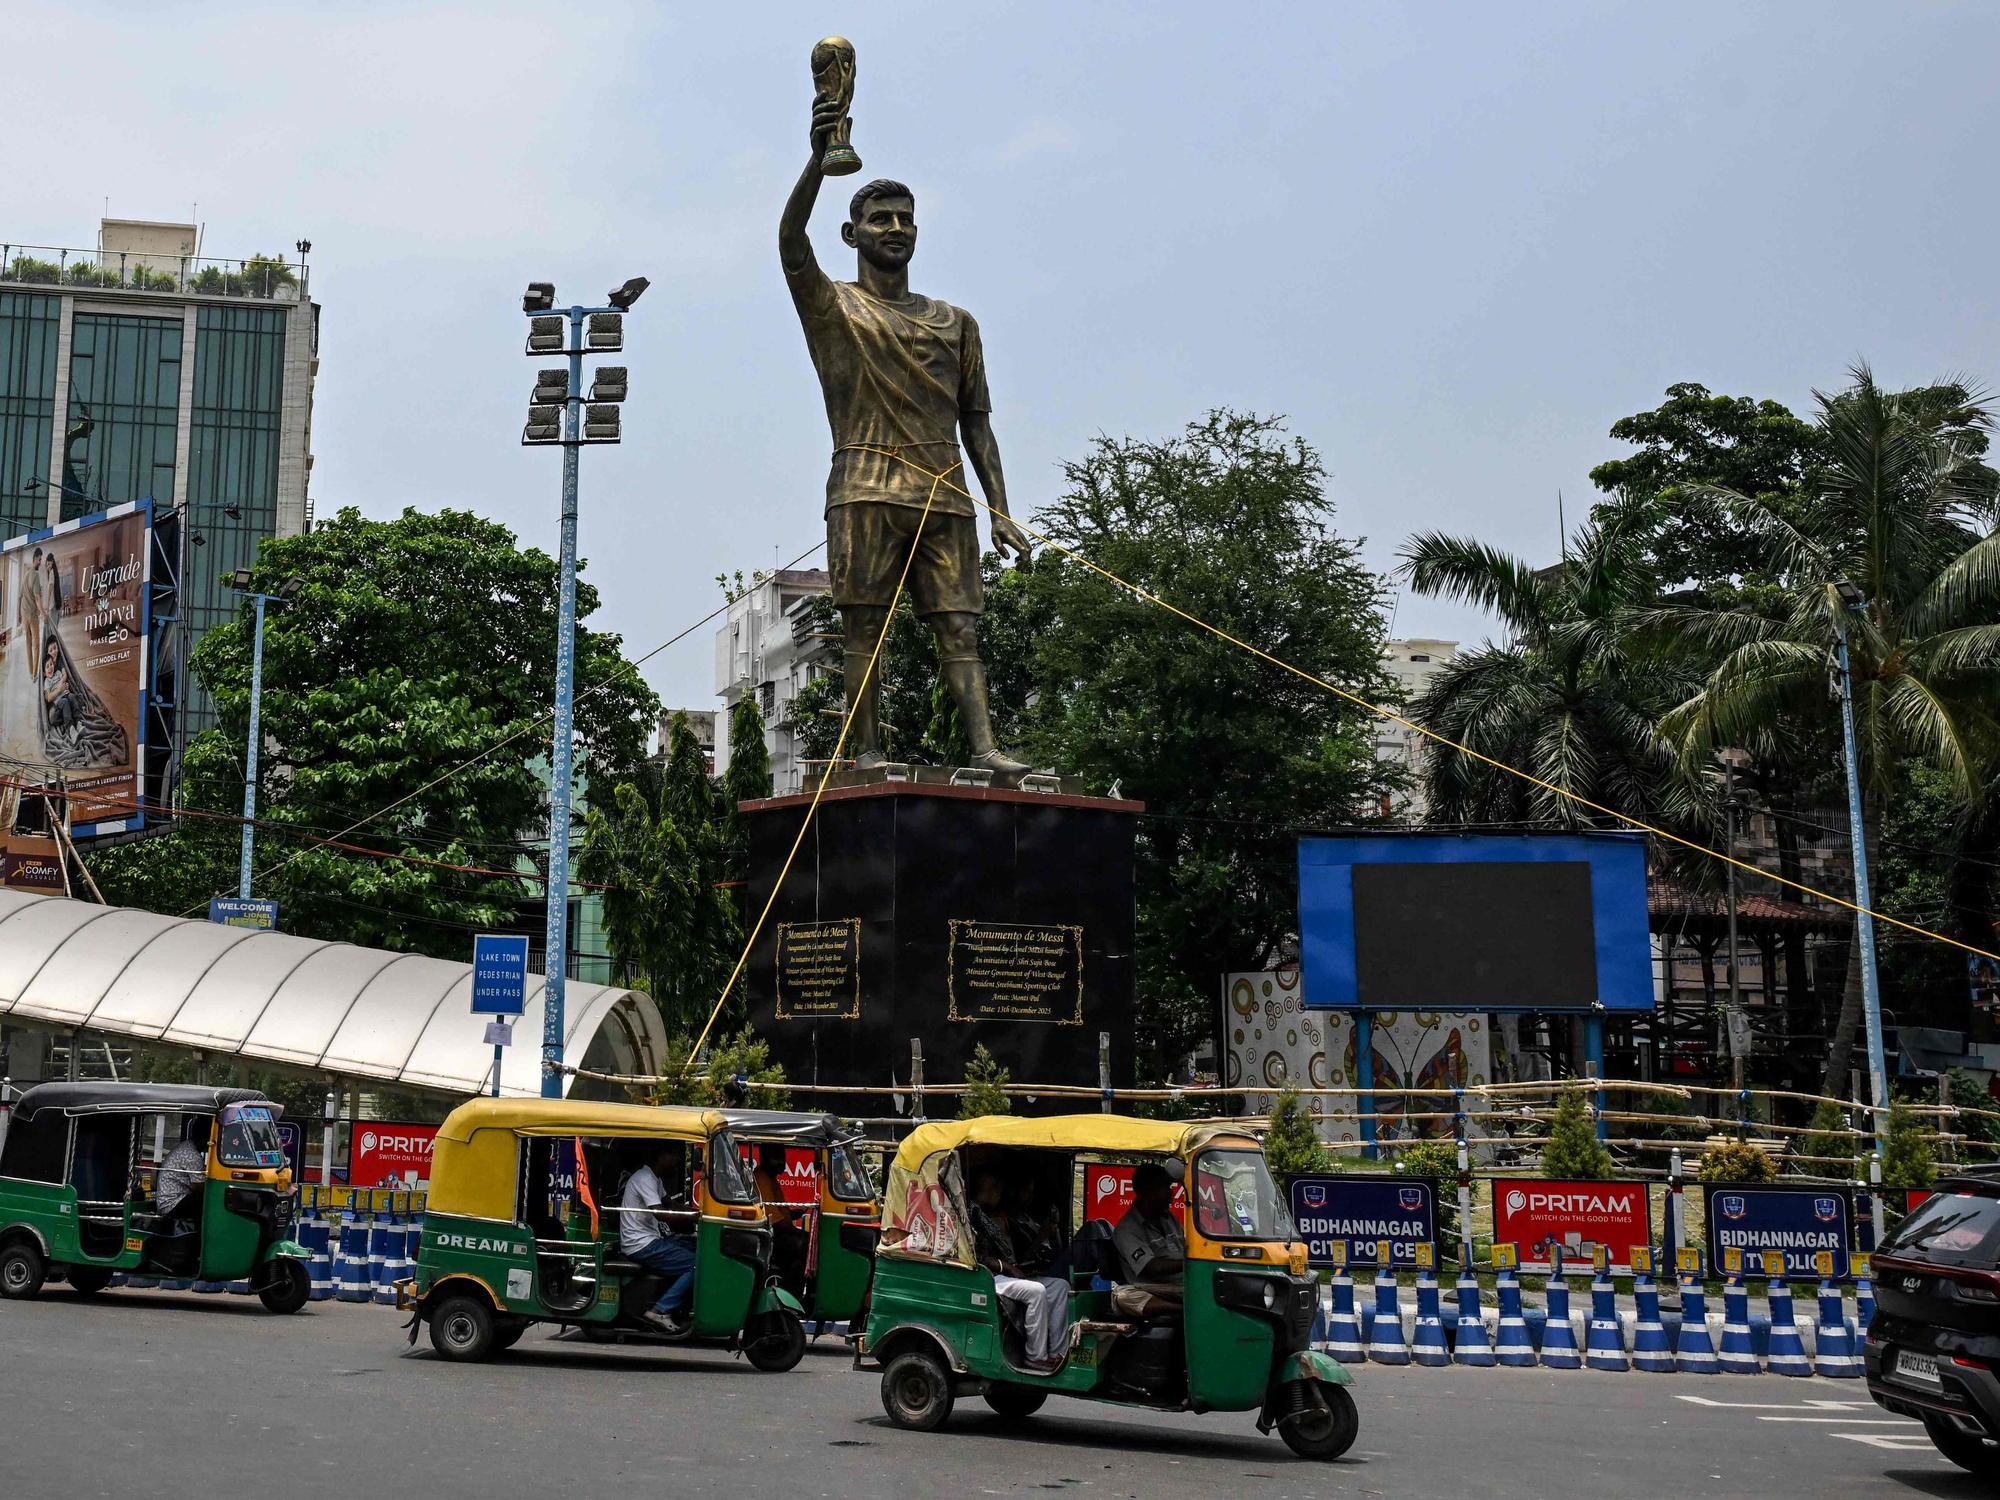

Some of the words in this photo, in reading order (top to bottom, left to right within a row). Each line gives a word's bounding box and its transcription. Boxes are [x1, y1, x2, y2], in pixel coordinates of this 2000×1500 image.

[81, 554, 140, 600] Upgrade
[90, 636, 108, 647] PHASE
[100, 653, 117, 665] MODEL
[118, 650, 130, 660] FLAT
[118, 774, 133, 782] FINISH
[25, 866, 58, 875] COMFY
[217, 902, 272, 912] WELCOME
[830, 926, 848, 937] Messi
[966, 928, 1022, 941] Monumento
[1024, 930, 1034, 940] de
[1037, 932, 1064, 942] Messi
[481, 954, 499, 962] LAKE
[502, 954, 520, 962] TOWN
[1009, 957, 1015, 966] of
[478, 970, 520, 980] PEDESTRIAN
[991, 968, 1023, 977] Government
[1024, 970, 1030, 979] of
[1047, 971, 1066, 980] Bengal
[477, 988, 500, 997] UNDER
[503, 989, 520, 997] PASS
[1024, 982, 1047, 991] Sporting
[380, 1135, 435, 1153] PRITA
[1530, 1194, 1631, 1213] PRITAM
[1300, 1218, 1424, 1236] BIDHANNAGAR
[437, 1234, 508, 1252] DREAM
[1720, 1230, 1839, 1248] BIDHANNAGAR
[1310, 1240, 1333, 1255] CIT
[1355, 1241, 1416, 1258] POCE
[1746, 1254, 1763, 1268] TY
[1788, 1254, 1818, 1270] OLIC
[1901, 1354, 1938, 1376] WB02AS362
